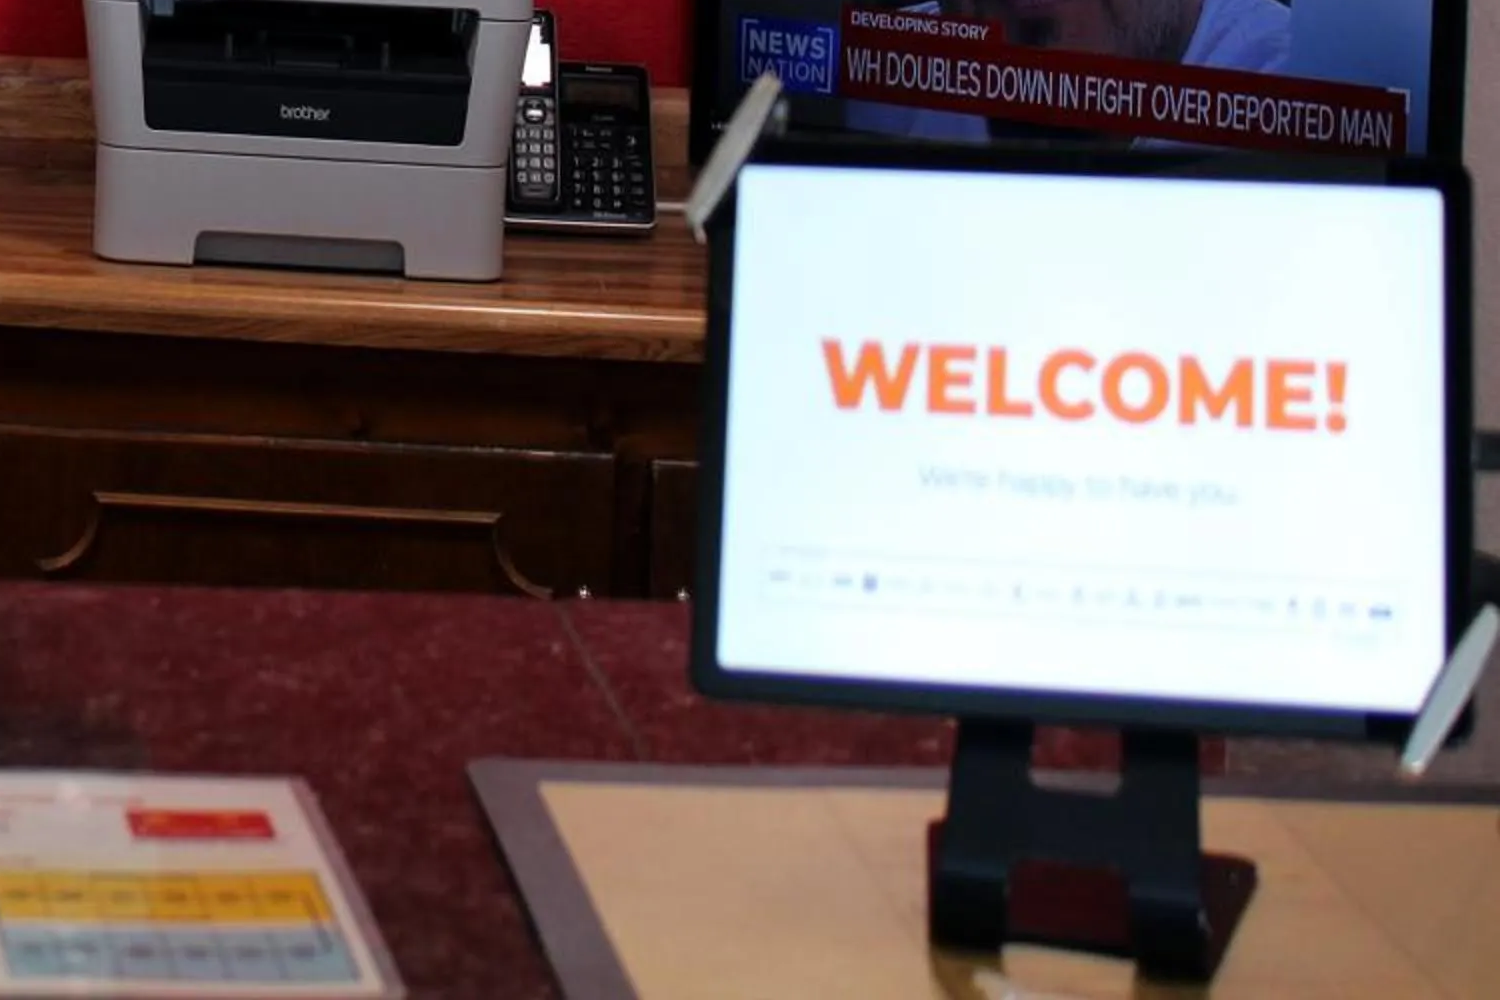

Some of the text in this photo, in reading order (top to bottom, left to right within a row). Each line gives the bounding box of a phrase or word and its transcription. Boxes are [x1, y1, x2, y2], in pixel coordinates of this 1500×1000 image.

[851, 10, 990, 41] DEVELOPING STORY
[749, 29, 826, 59] NEWS
[747, 56, 825, 84] NATION
[280, 104, 330, 121] brother
[847, 46, 1393, 149] WH DOUBLES DOWN IN FIGHT OVER DEPORTED MAN
[820, 338, 1349, 434] WELCOME!
